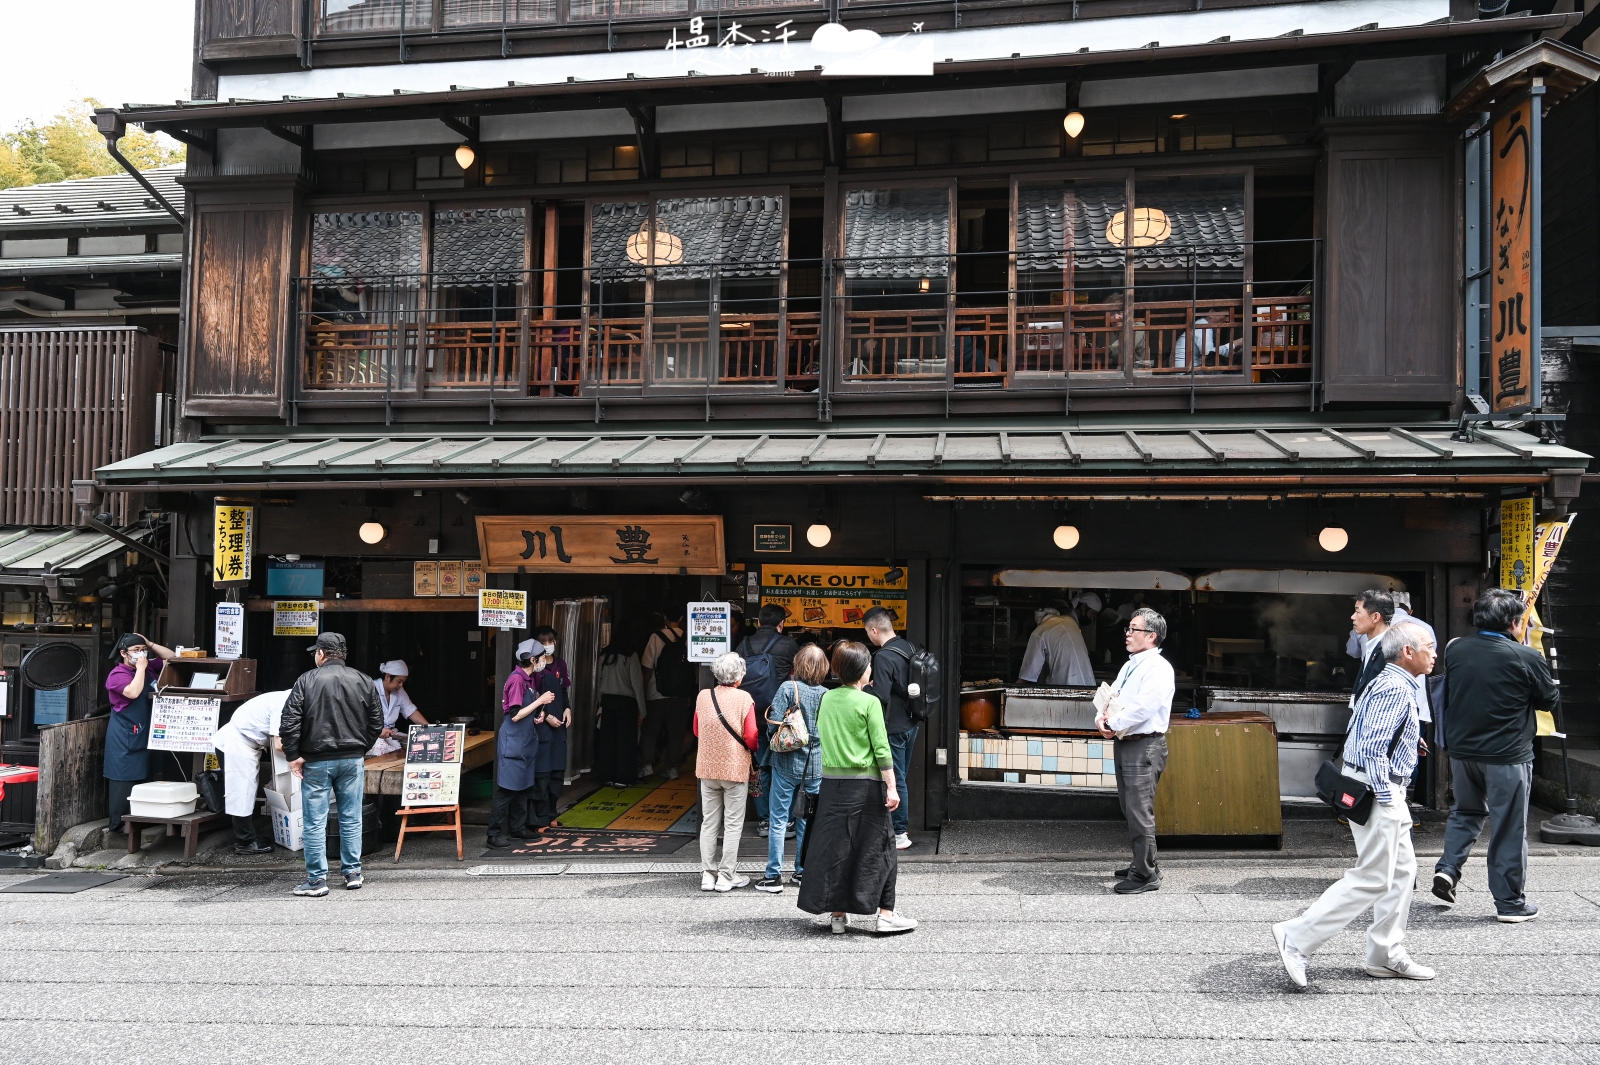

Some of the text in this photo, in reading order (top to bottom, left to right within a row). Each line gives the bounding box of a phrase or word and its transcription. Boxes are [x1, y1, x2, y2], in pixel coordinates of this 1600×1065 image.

[218, 511, 227, 554] こちら
[228, 508, 245, 577] 整理券
[519, 525, 660, 564] 川豊
[286, 574, 306, 590] 77
[771, 573, 870, 587] TAKE OUT
[701, 647, 715, 655] 20分
